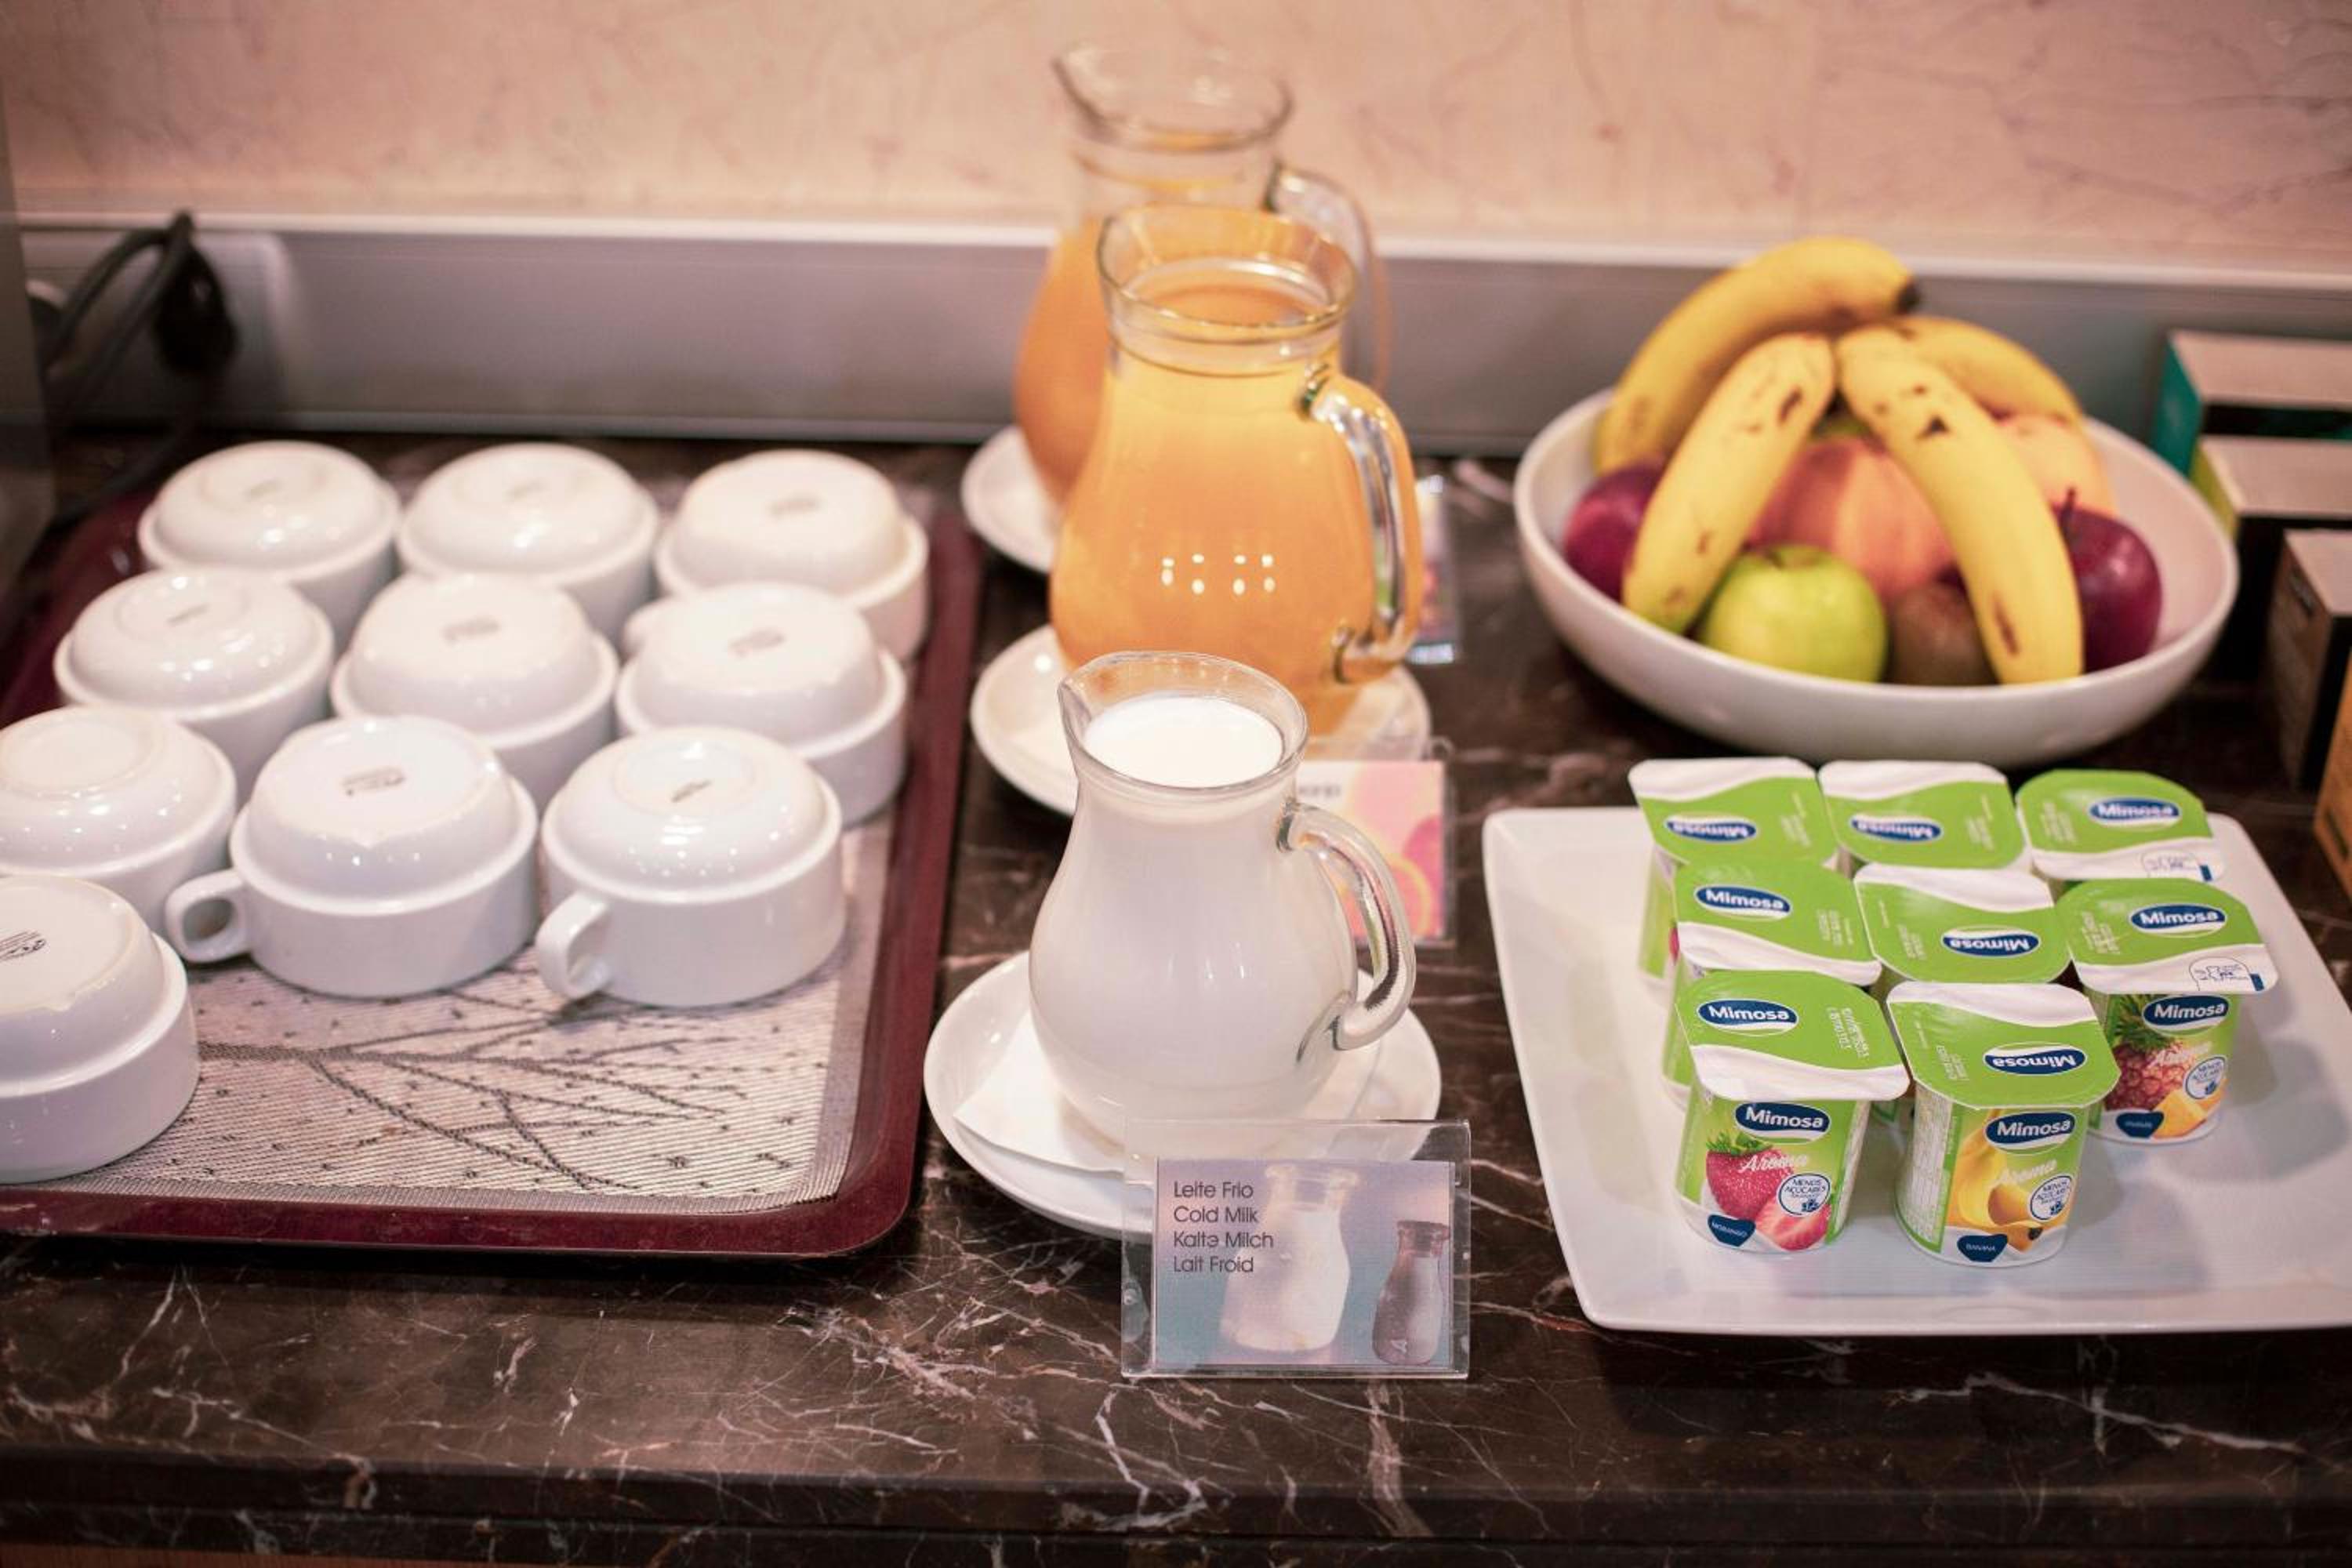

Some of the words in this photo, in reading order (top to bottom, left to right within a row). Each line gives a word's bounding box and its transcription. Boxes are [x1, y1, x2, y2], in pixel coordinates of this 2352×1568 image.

[2097, 803, 2173, 818] Mimosa
[1673, 822, 1748, 838] Mimosa
[1857, 821, 1933, 838] Mimosa
[1706, 889, 1784, 909] Mimosa
[2140, 909, 2218, 925] Mimosa
[1951, 936, 2031, 950] Mimosa
[1709, 1004, 1789, 1020] Mimosa
[2154, 1002, 2224, 1019] Mimosa
[1992, 1054, 2076, 1068] Mimosa
[1745, 1106, 1824, 1128] Mimosa
[1997, 1119, 2070, 1137] Mimosa
[1174, 1181, 1216, 1198] Leite
[1222, 1181, 1254, 1198] Frio
[1174, 1206, 1218, 1223] Cold
[1225, 1206, 1258, 1223] Milk
[1174, 1231, 1218, 1248] Kalte
[1225, 1231, 1274, 1248] Milch
[1174, 1256, 1203, 1273] Lait
[1211, 1256, 1254, 1273] Froid
